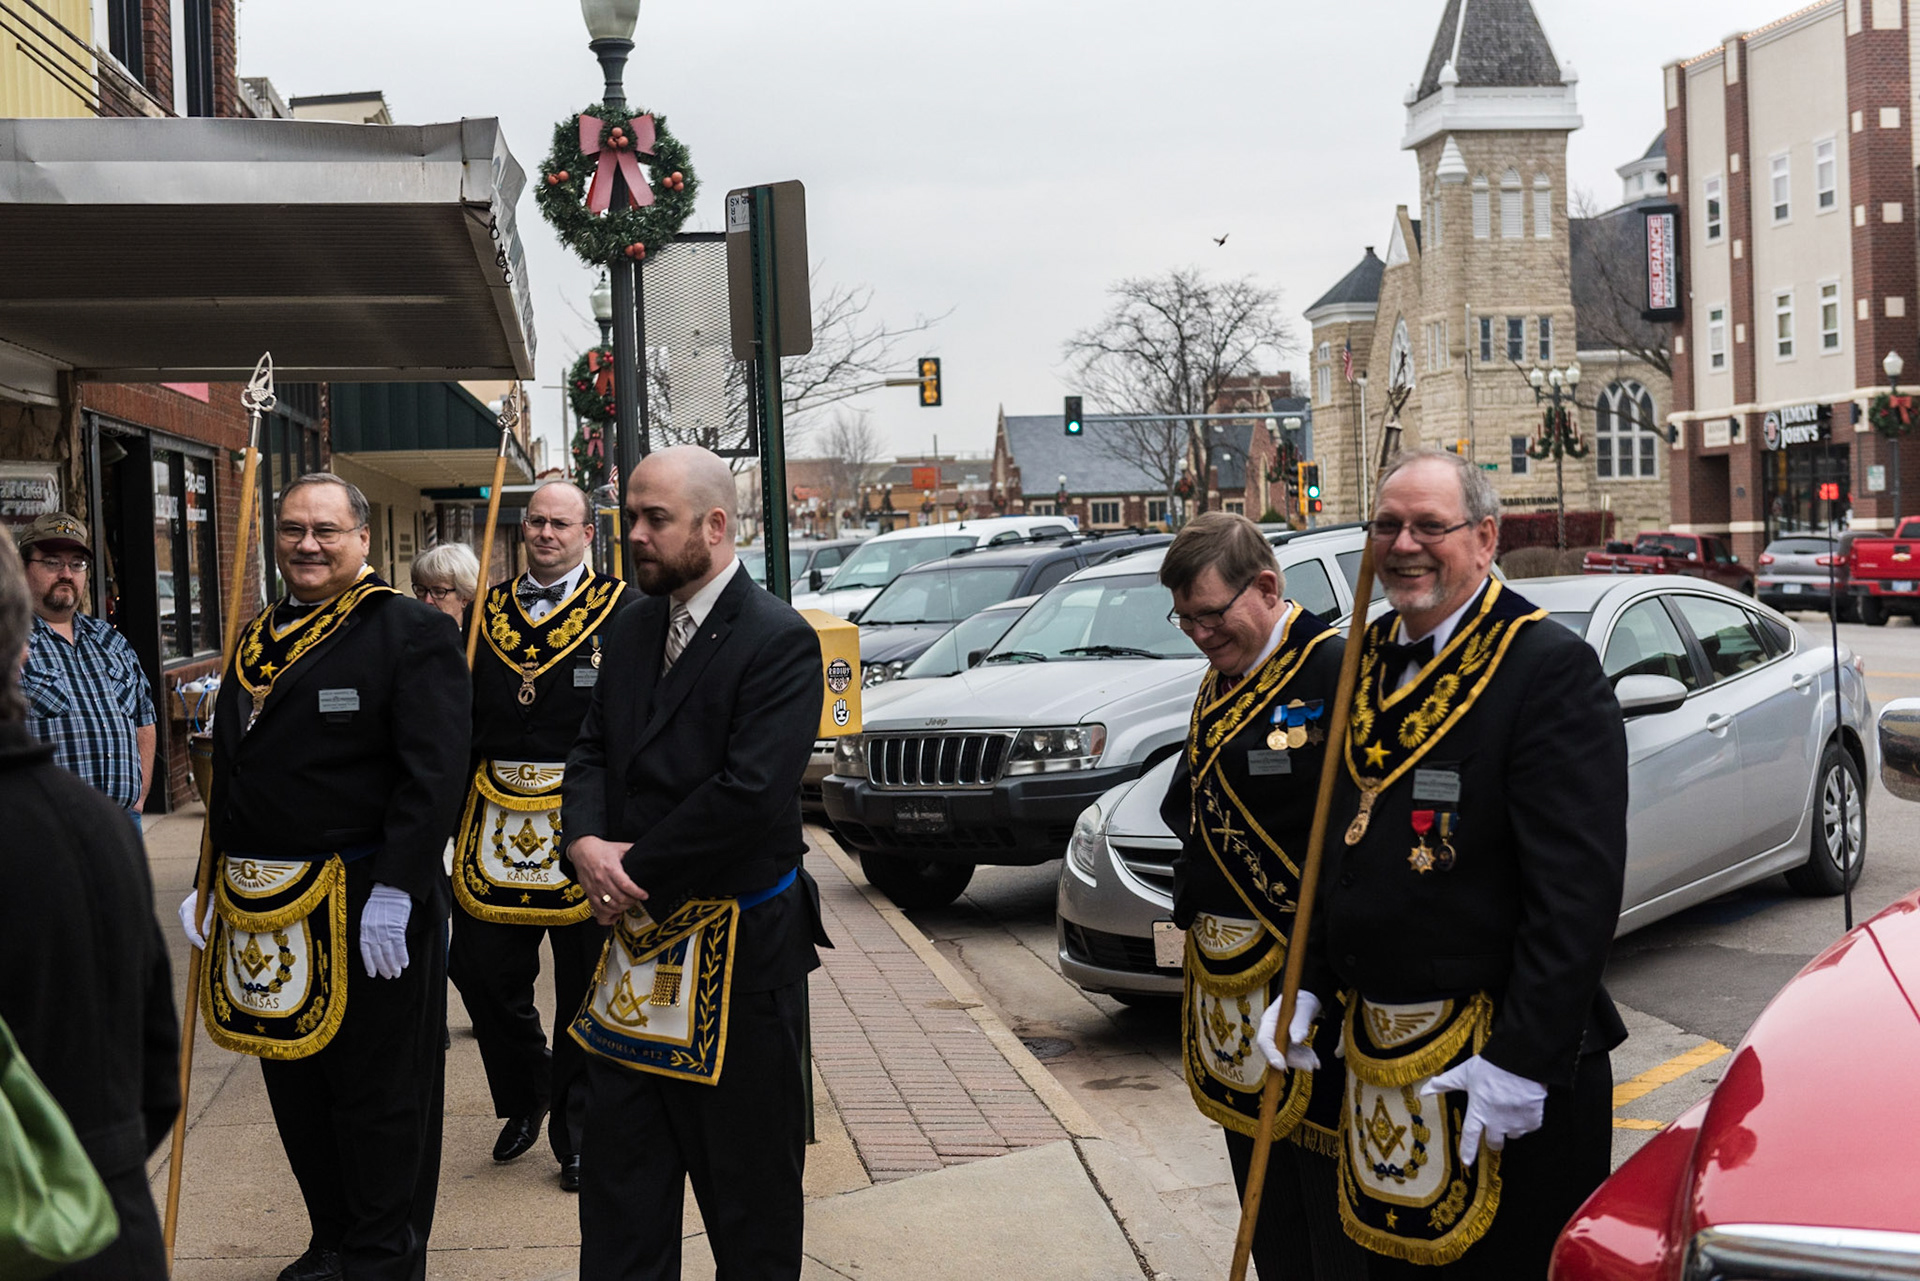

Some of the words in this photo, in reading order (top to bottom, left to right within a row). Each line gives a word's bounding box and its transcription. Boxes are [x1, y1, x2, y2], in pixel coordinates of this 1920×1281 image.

[1663, 216, 1671, 254] CENTER
[1650, 217, 1664, 306] INSURANCE
[1780, 405, 1818, 428] JIMMY
[1780, 424, 1819, 449] JOHN'S
[925, 717, 948, 727] Jeep
[518, 763, 538, 781] G
[241, 860, 259, 880] G
[507, 871, 549, 883] KANSAS
[1203, 915, 1219, 939] G
[242, 994, 280, 1009] KANSAS
[1214, 1059, 1245, 1083] KANSAS
